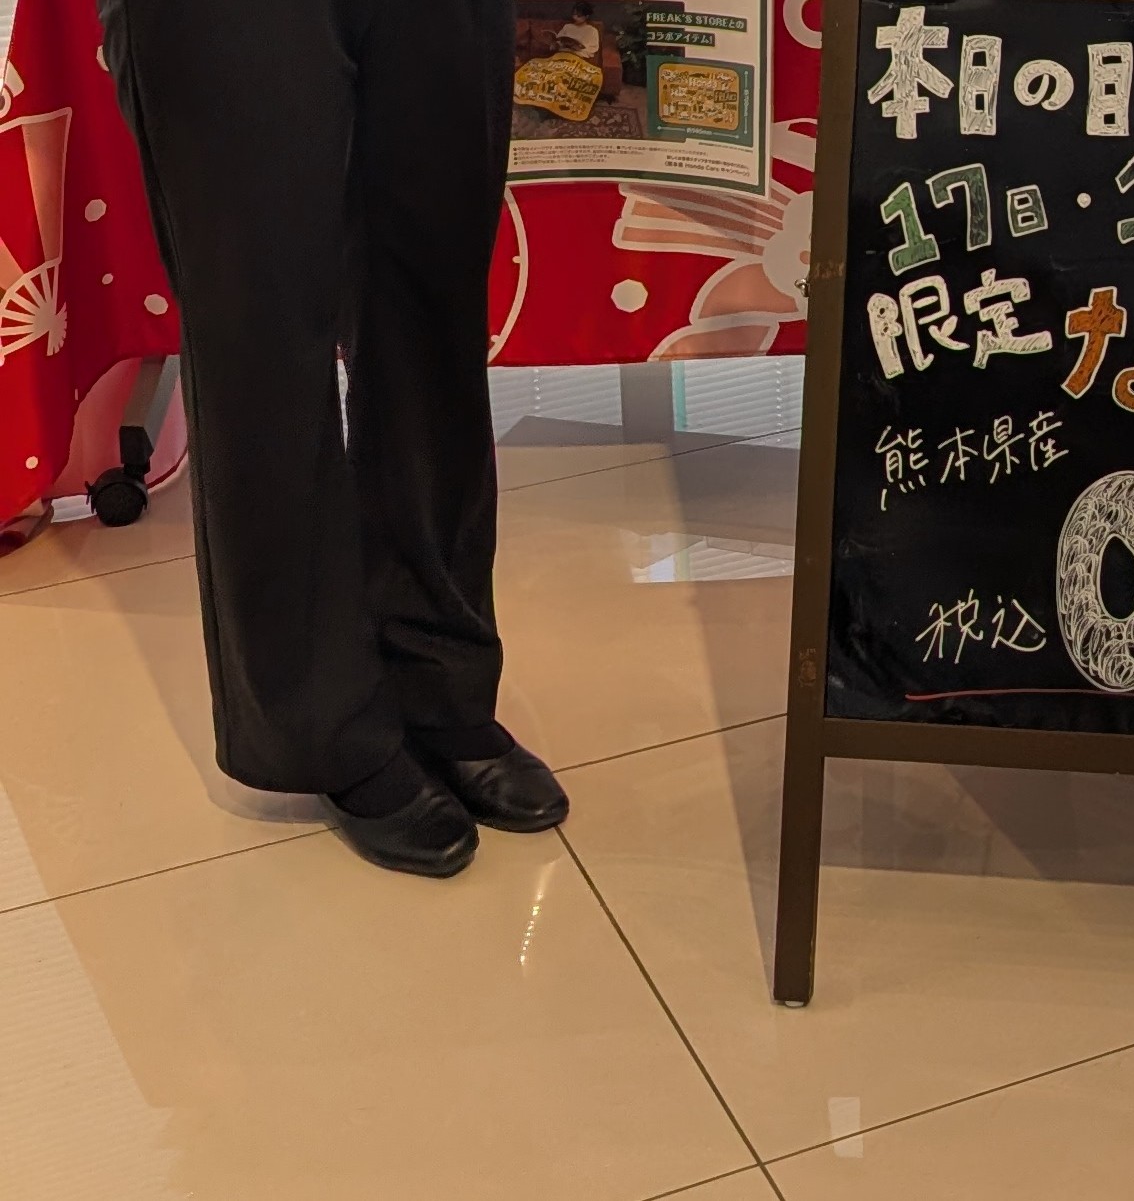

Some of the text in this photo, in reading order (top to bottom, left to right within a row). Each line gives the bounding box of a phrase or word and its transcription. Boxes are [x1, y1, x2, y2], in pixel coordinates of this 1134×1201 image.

[867, 267, 1053, 380] 限定
[875, 410, 1069, 511] 熊本県産
